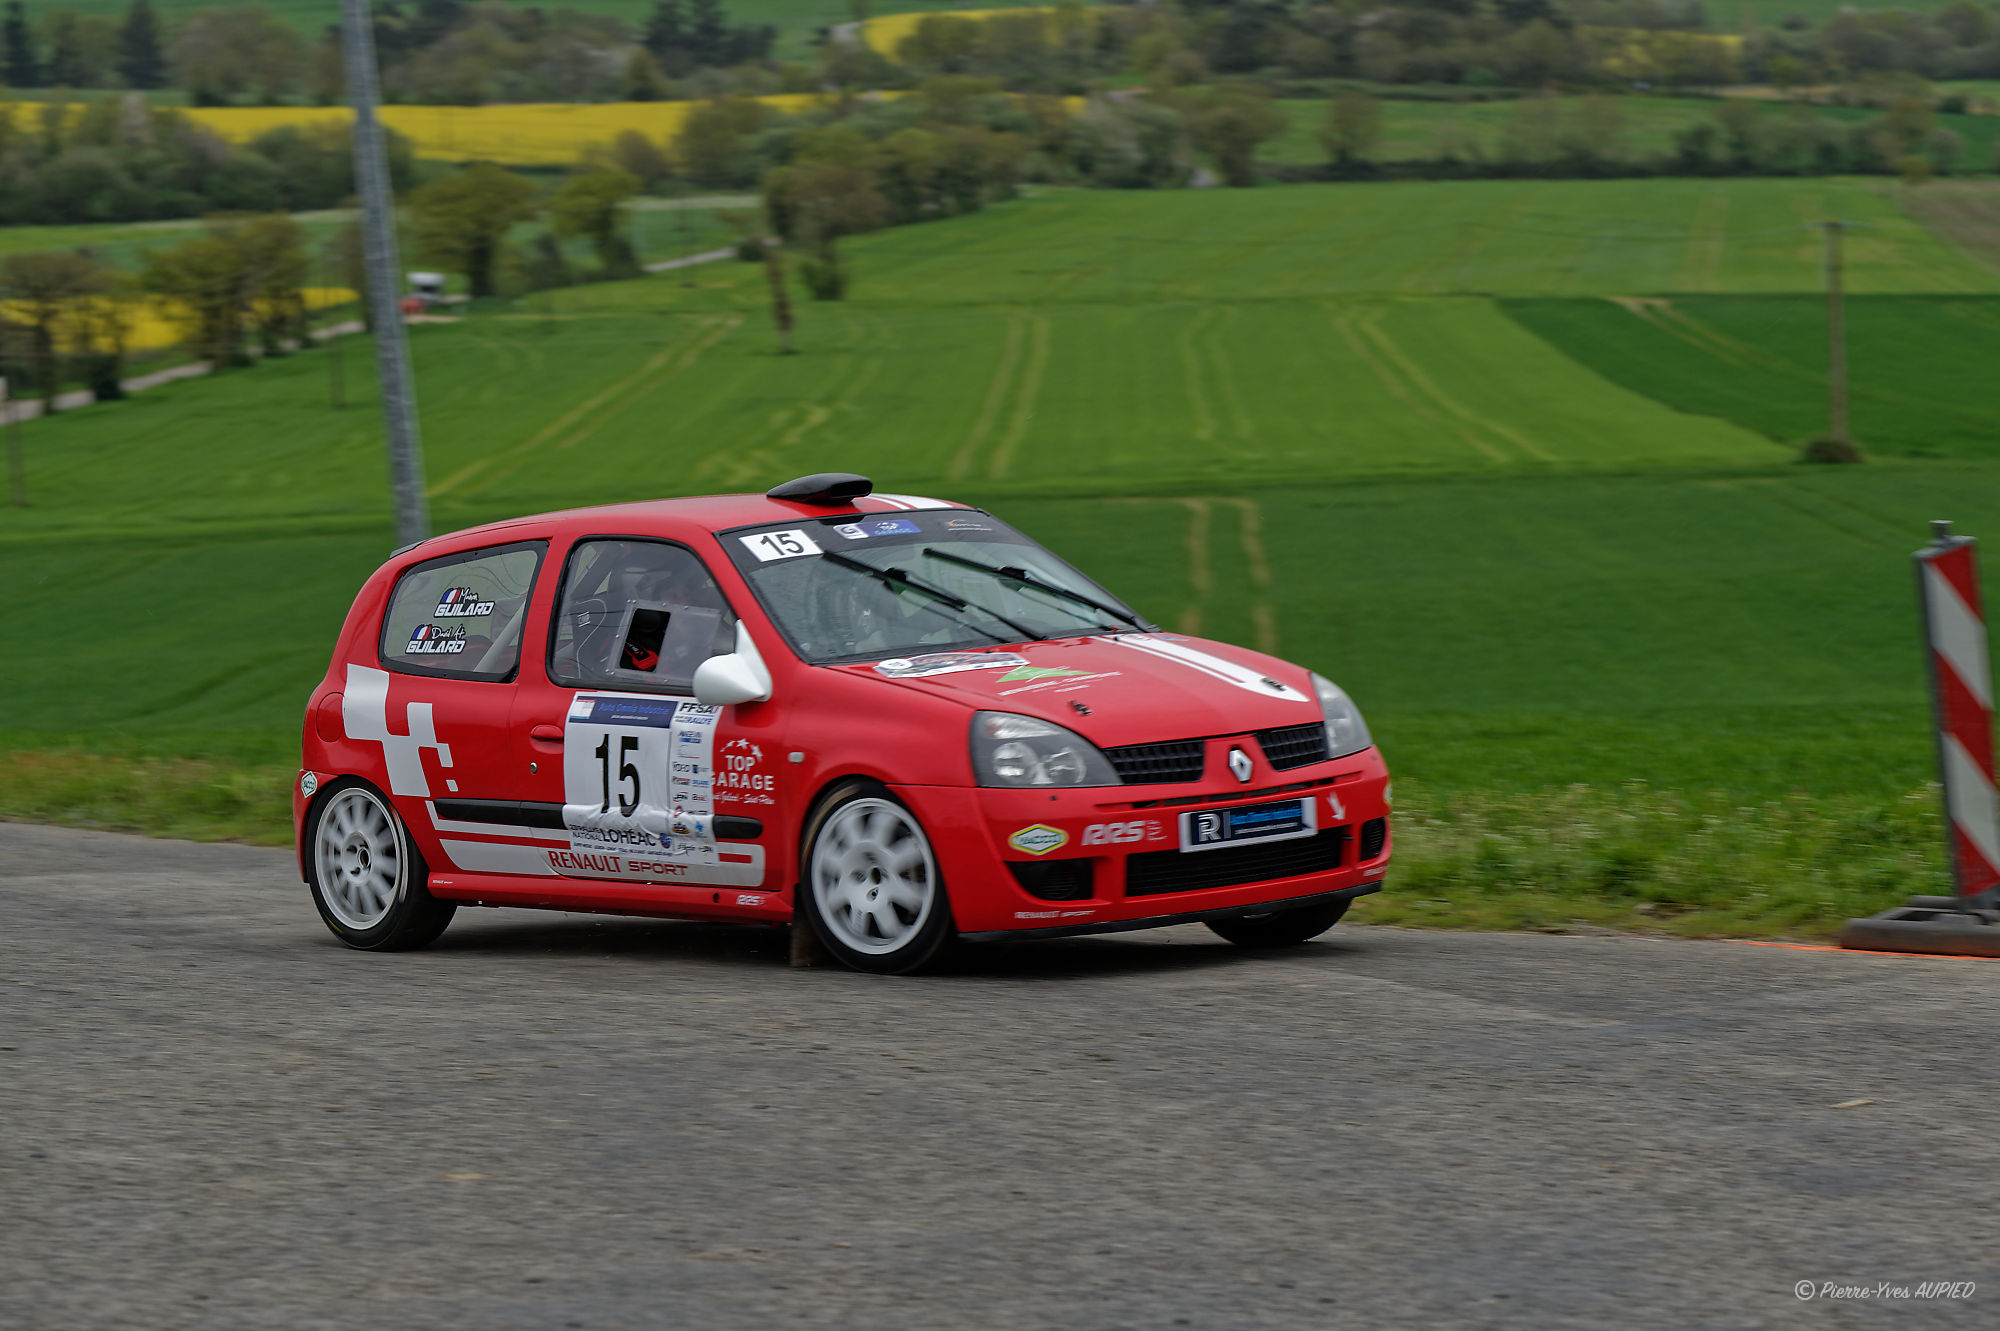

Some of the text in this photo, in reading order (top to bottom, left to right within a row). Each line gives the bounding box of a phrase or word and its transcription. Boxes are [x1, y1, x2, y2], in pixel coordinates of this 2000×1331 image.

[760, 533, 804, 555] 15
[434, 602, 494, 616] GUILARD
[405, 640, 465, 653] GUILARD
[679, 703, 713, 713] FFSA
[725, 754, 756, 771] TOP
[595, 733, 640, 817] 15
[548, 850, 688, 876] RENAULT SPORT
